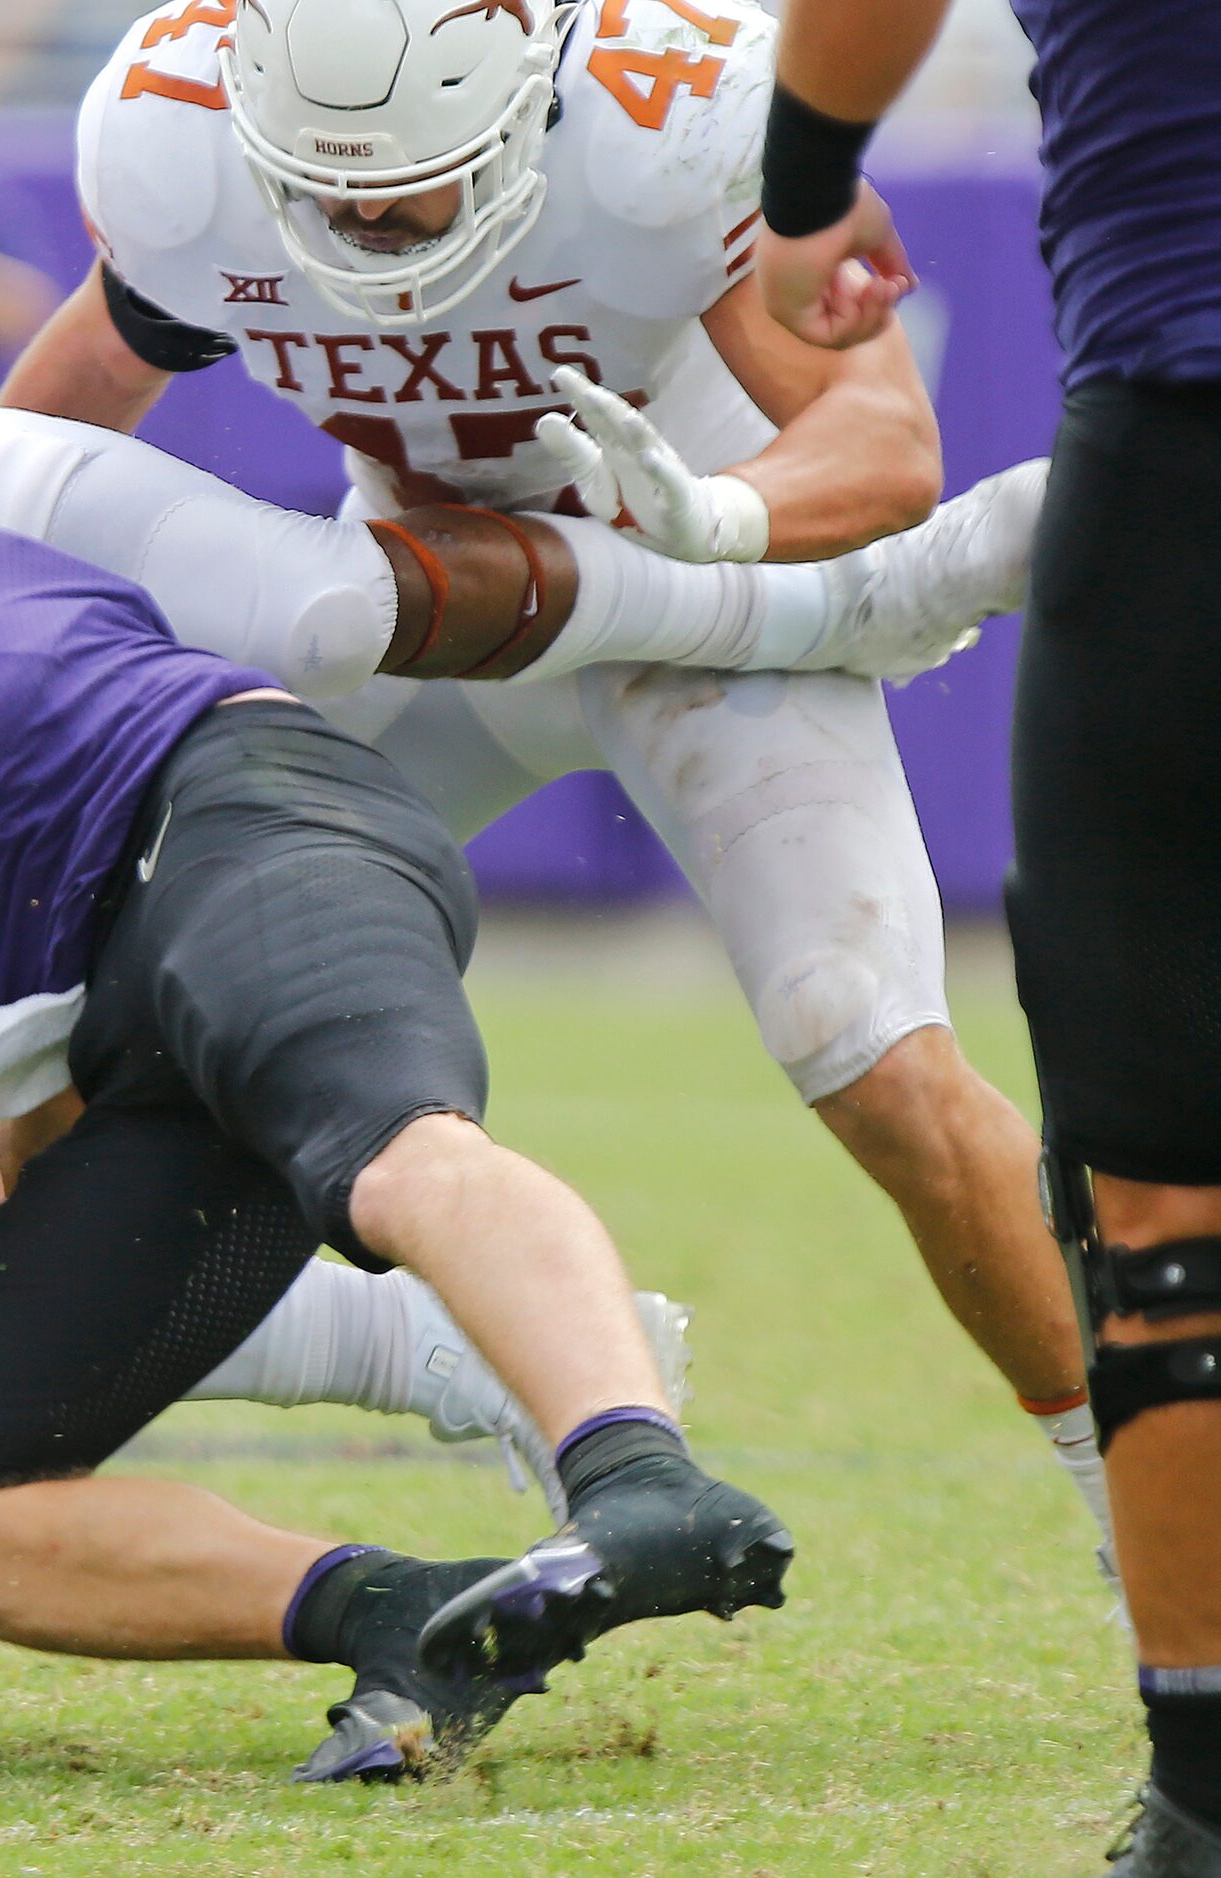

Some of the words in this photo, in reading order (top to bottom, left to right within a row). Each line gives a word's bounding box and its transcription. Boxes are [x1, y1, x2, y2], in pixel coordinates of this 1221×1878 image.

[587, 0, 741, 131] 47
[315, 137, 374, 158] HORNS
[219, 269, 290, 307] XII
[244, 323, 604, 403] TEXAS
